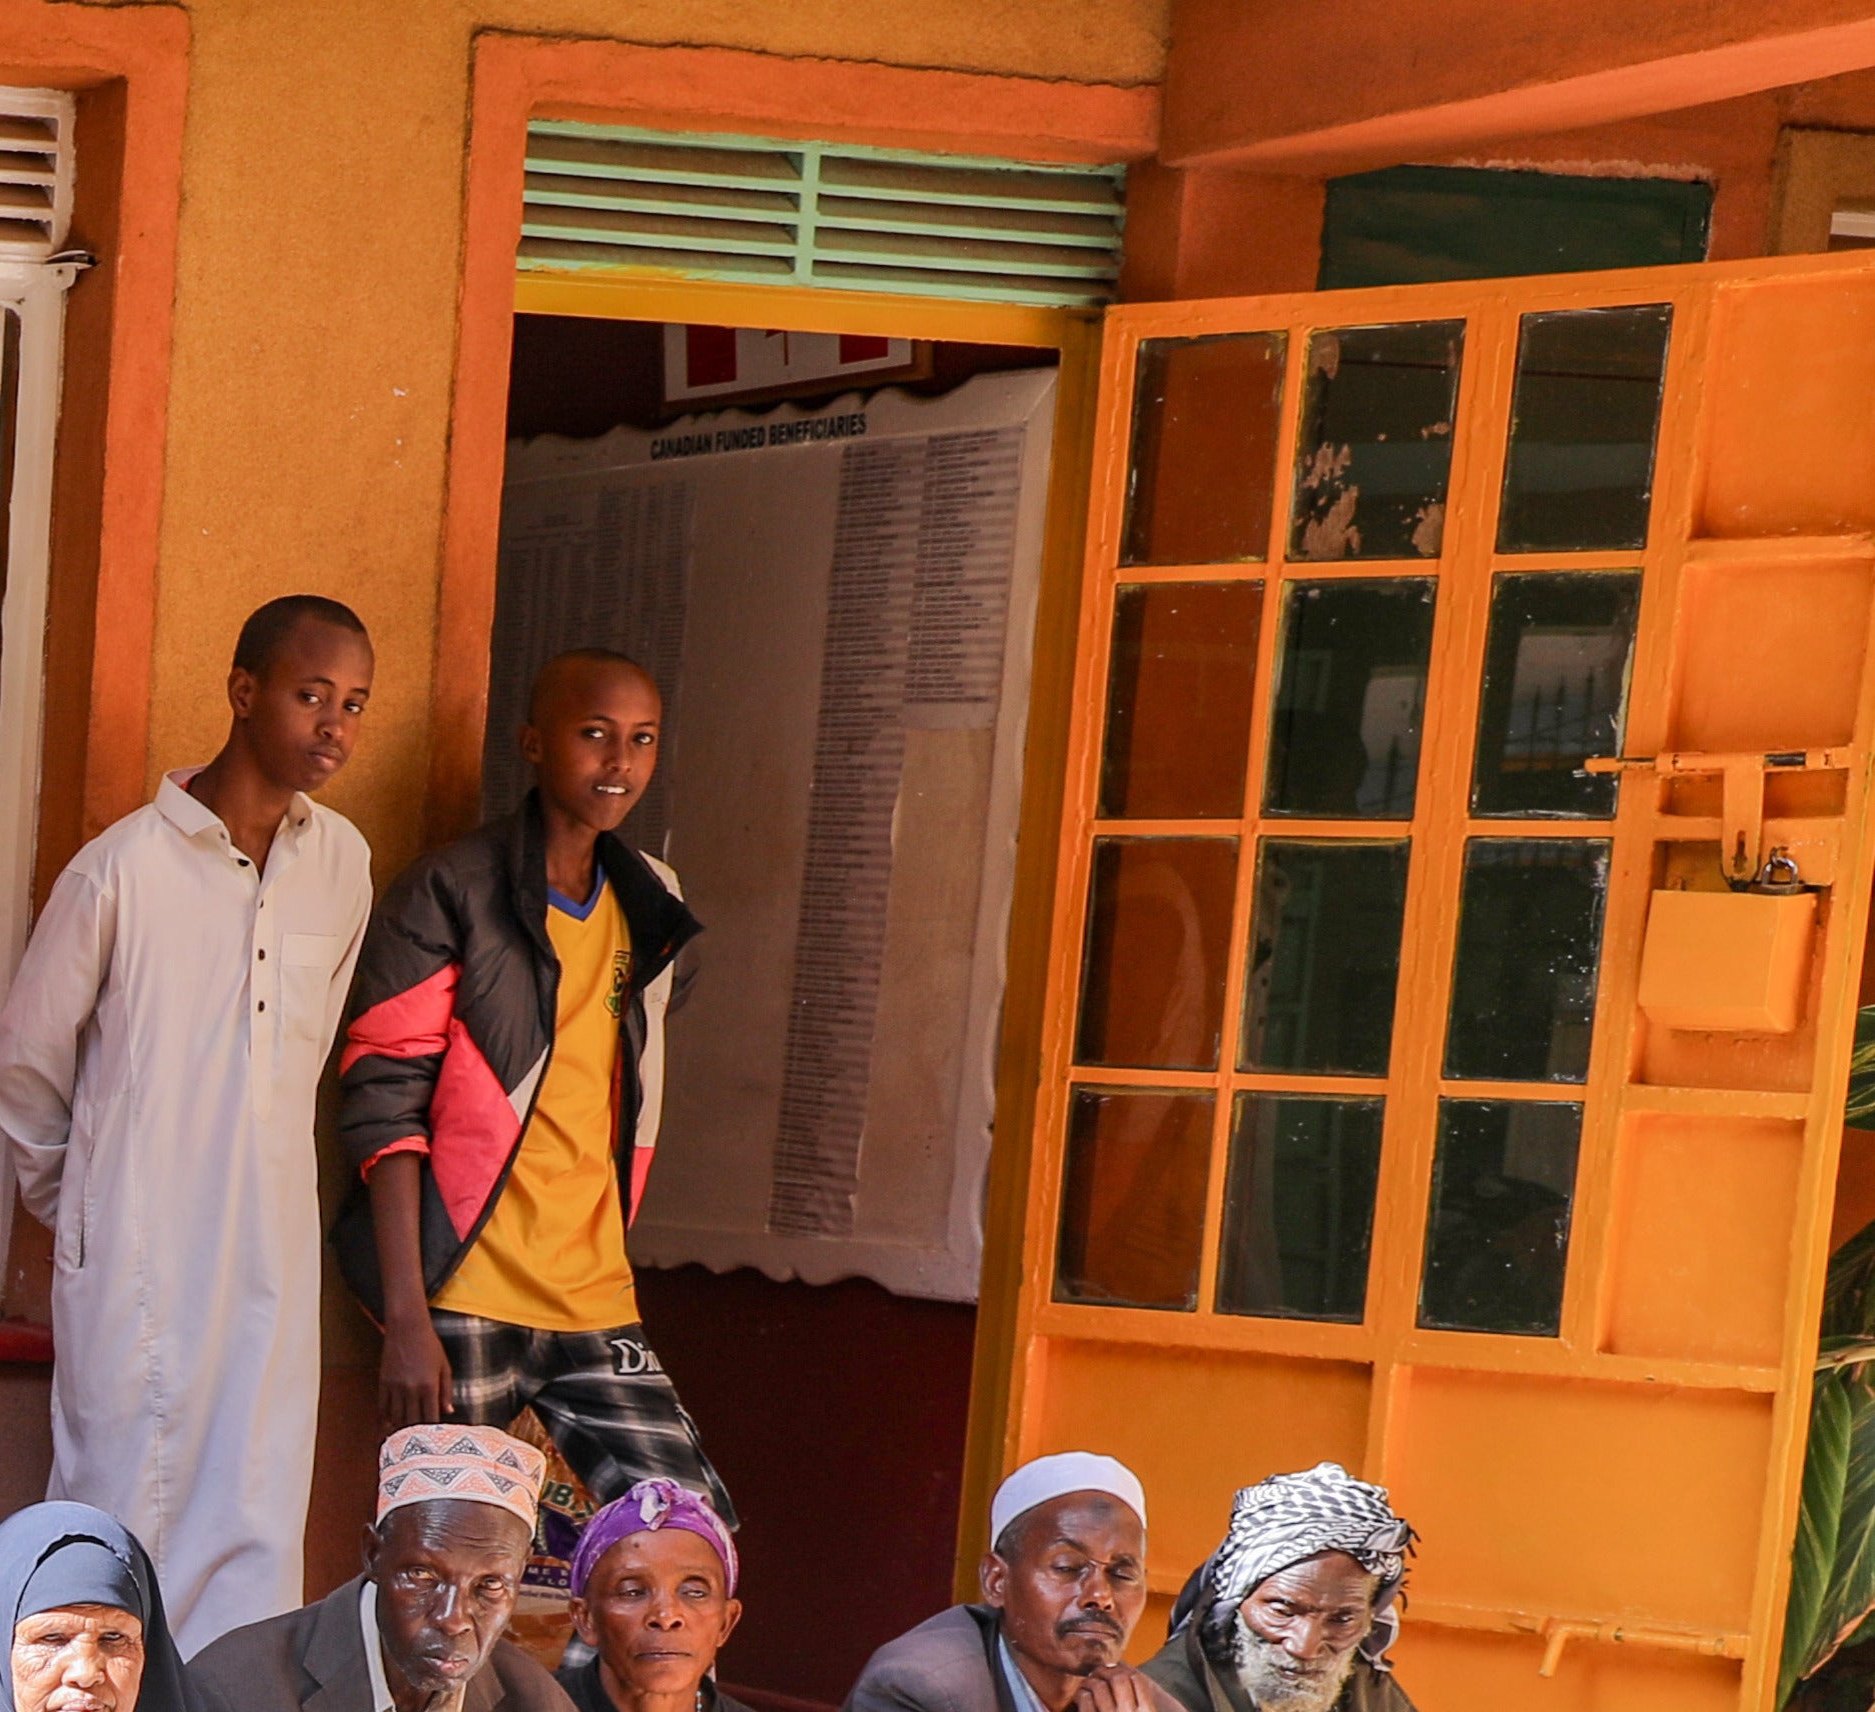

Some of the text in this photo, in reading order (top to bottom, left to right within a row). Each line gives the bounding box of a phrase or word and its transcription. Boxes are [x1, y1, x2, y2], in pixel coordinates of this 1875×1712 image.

[650, 413, 867, 460] CANADIAN FUNDED BENEFICIARIES
